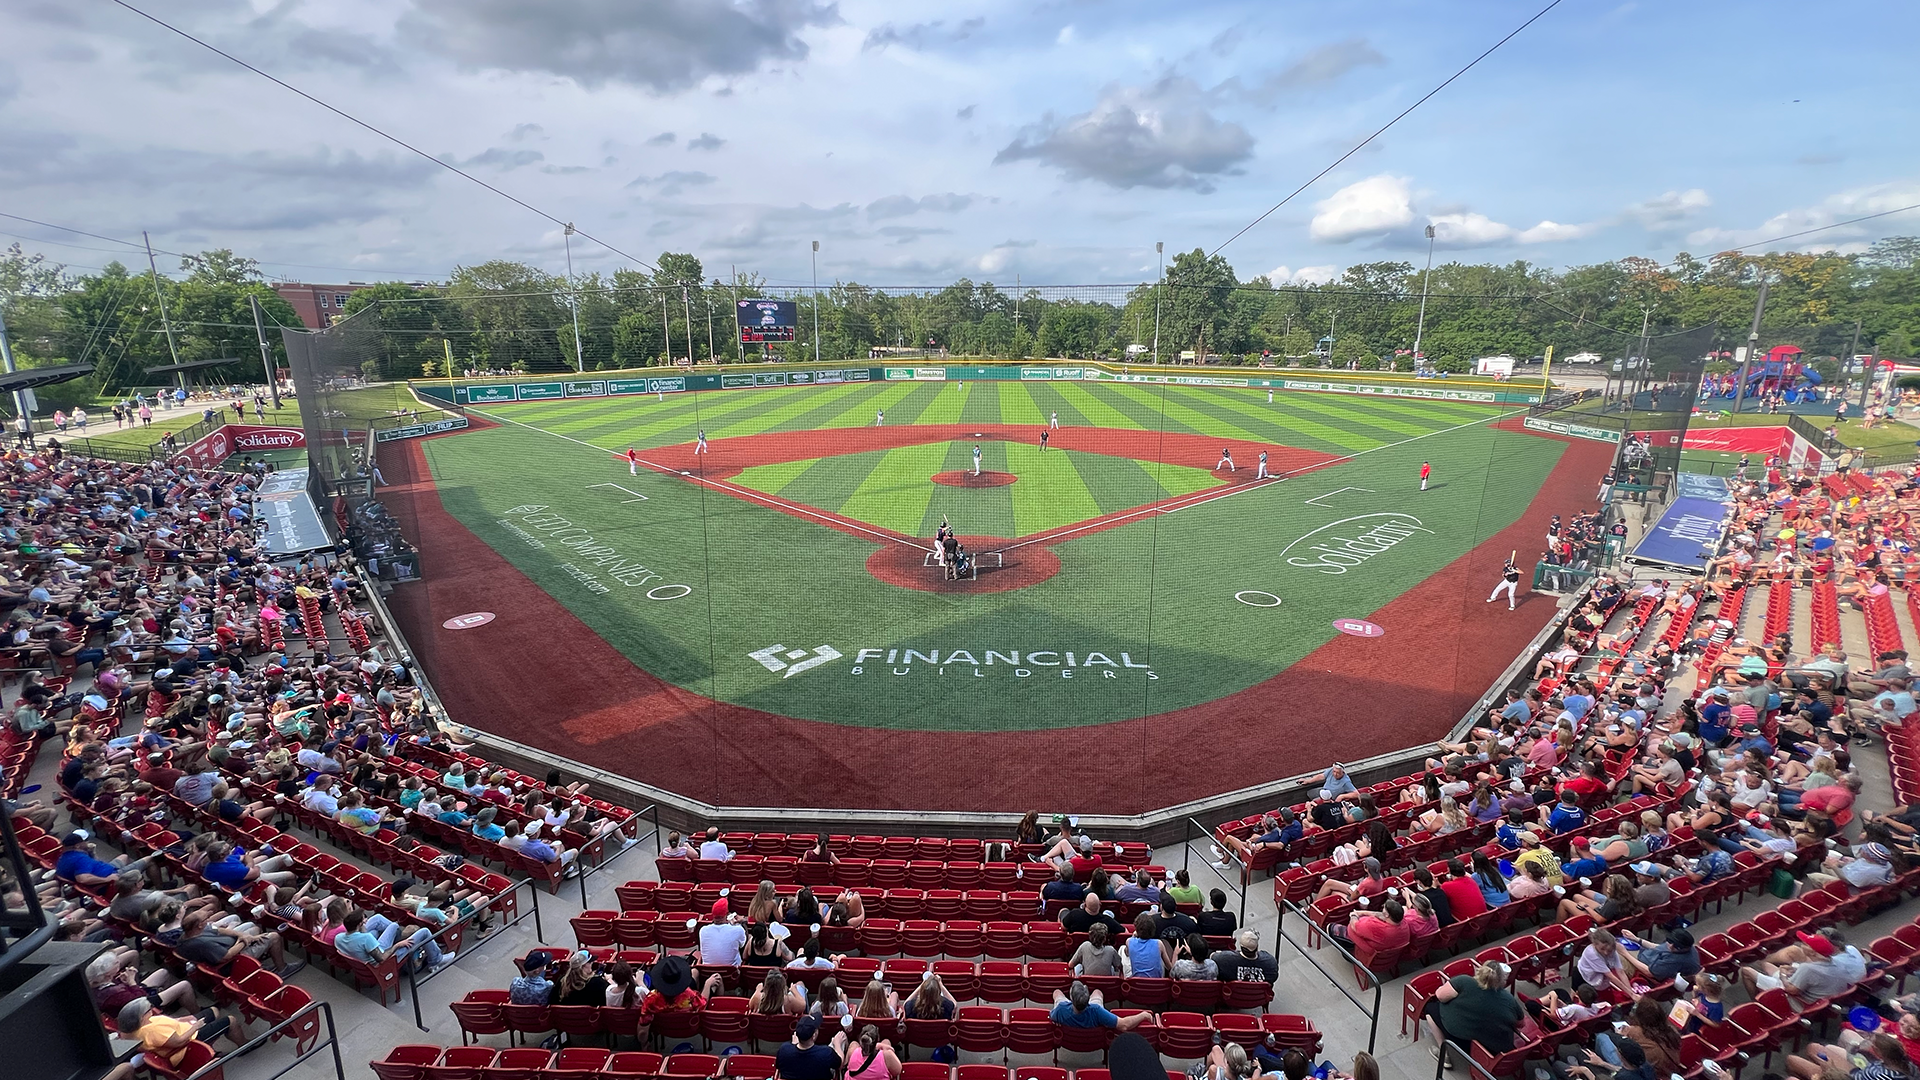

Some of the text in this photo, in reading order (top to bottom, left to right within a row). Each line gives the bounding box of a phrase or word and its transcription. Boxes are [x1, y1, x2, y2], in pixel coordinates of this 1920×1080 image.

[235, 433, 295, 448] Solidarity
[1287, 519, 1435, 574] Solidarity
[853, 648, 1151, 669] FINANCIAL
[851, 665, 1160, 681] BUILDERS
[1536, 852, 1554, 864] YOU
